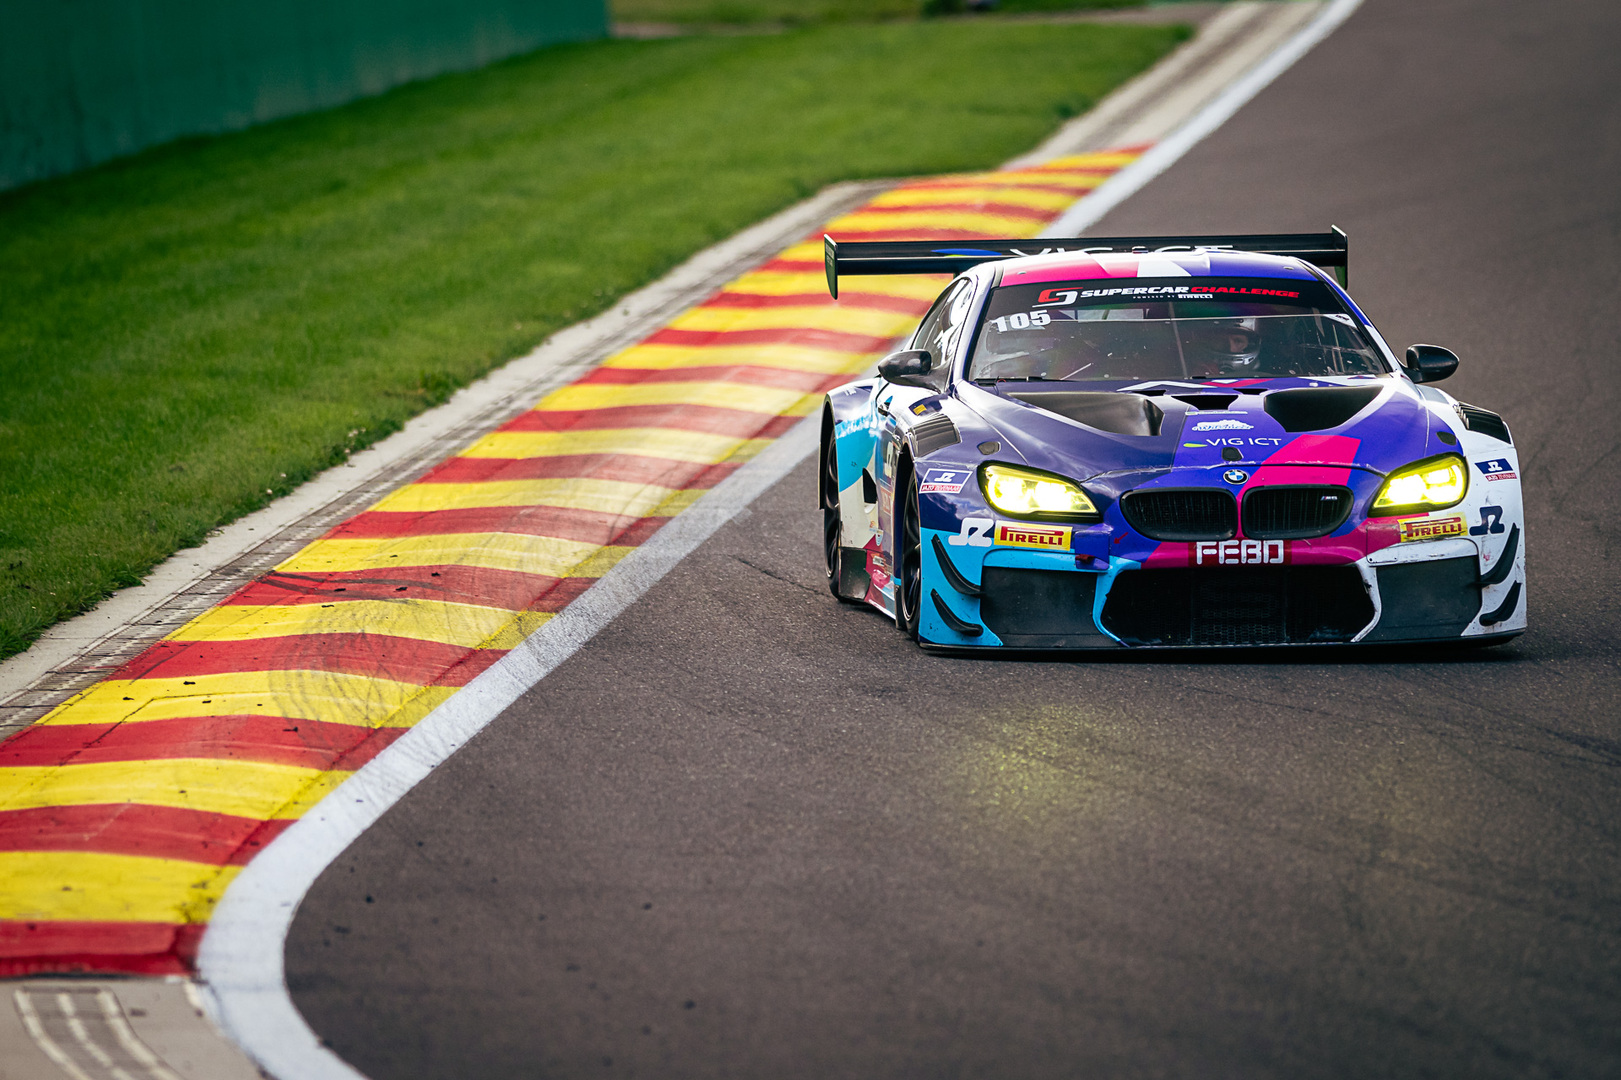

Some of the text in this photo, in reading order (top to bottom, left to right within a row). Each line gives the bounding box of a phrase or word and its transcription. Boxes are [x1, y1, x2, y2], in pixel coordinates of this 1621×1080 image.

[1080, 286, 1300, 298] SUPERCAR CHALLENGE
[991, 309, 1051, 333] 105
[1206, 437, 1282, 446] VIG ICT
[1000, 526, 1064, 546] PIRELLI
[1404, 516, 1462, 538] PIRELLI
